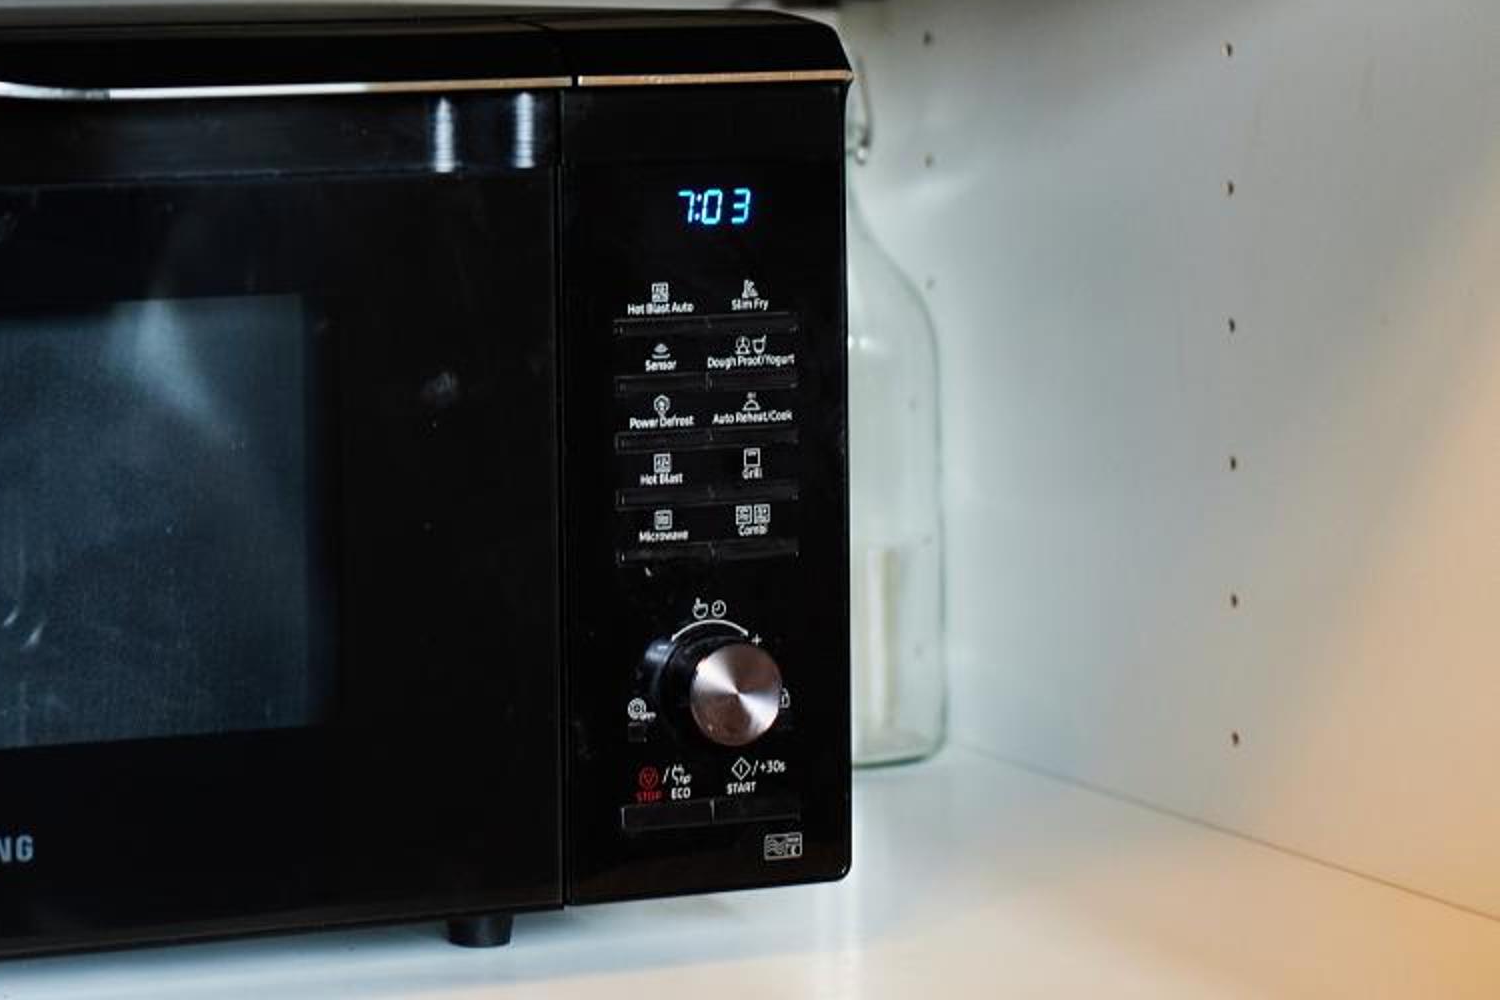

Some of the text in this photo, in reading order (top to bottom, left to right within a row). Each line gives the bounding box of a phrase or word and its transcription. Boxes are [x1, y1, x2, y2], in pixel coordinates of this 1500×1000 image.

[678, 188, 751, 225] 7:03
[627, 301, 695, 315] Hot Blast Auto
[731, 297, 769, 311] Slim Fry
[645, 359, 677, 372] Sensor
[707, 355, 736, 370] Dough
[629, 415, 695, 429] Power Defrost
[712, 409, 793, 425] Auto Reheat/Cook
[640, 472, 684, 485] Hot Blast
[742, 466, 763, 480] Grill
[639, 530, 689, 543] Microwave
[737, 523, 768, 537] Combi
[671, 786, 691, 800] ECO
[726, 781, 757, 795] START
